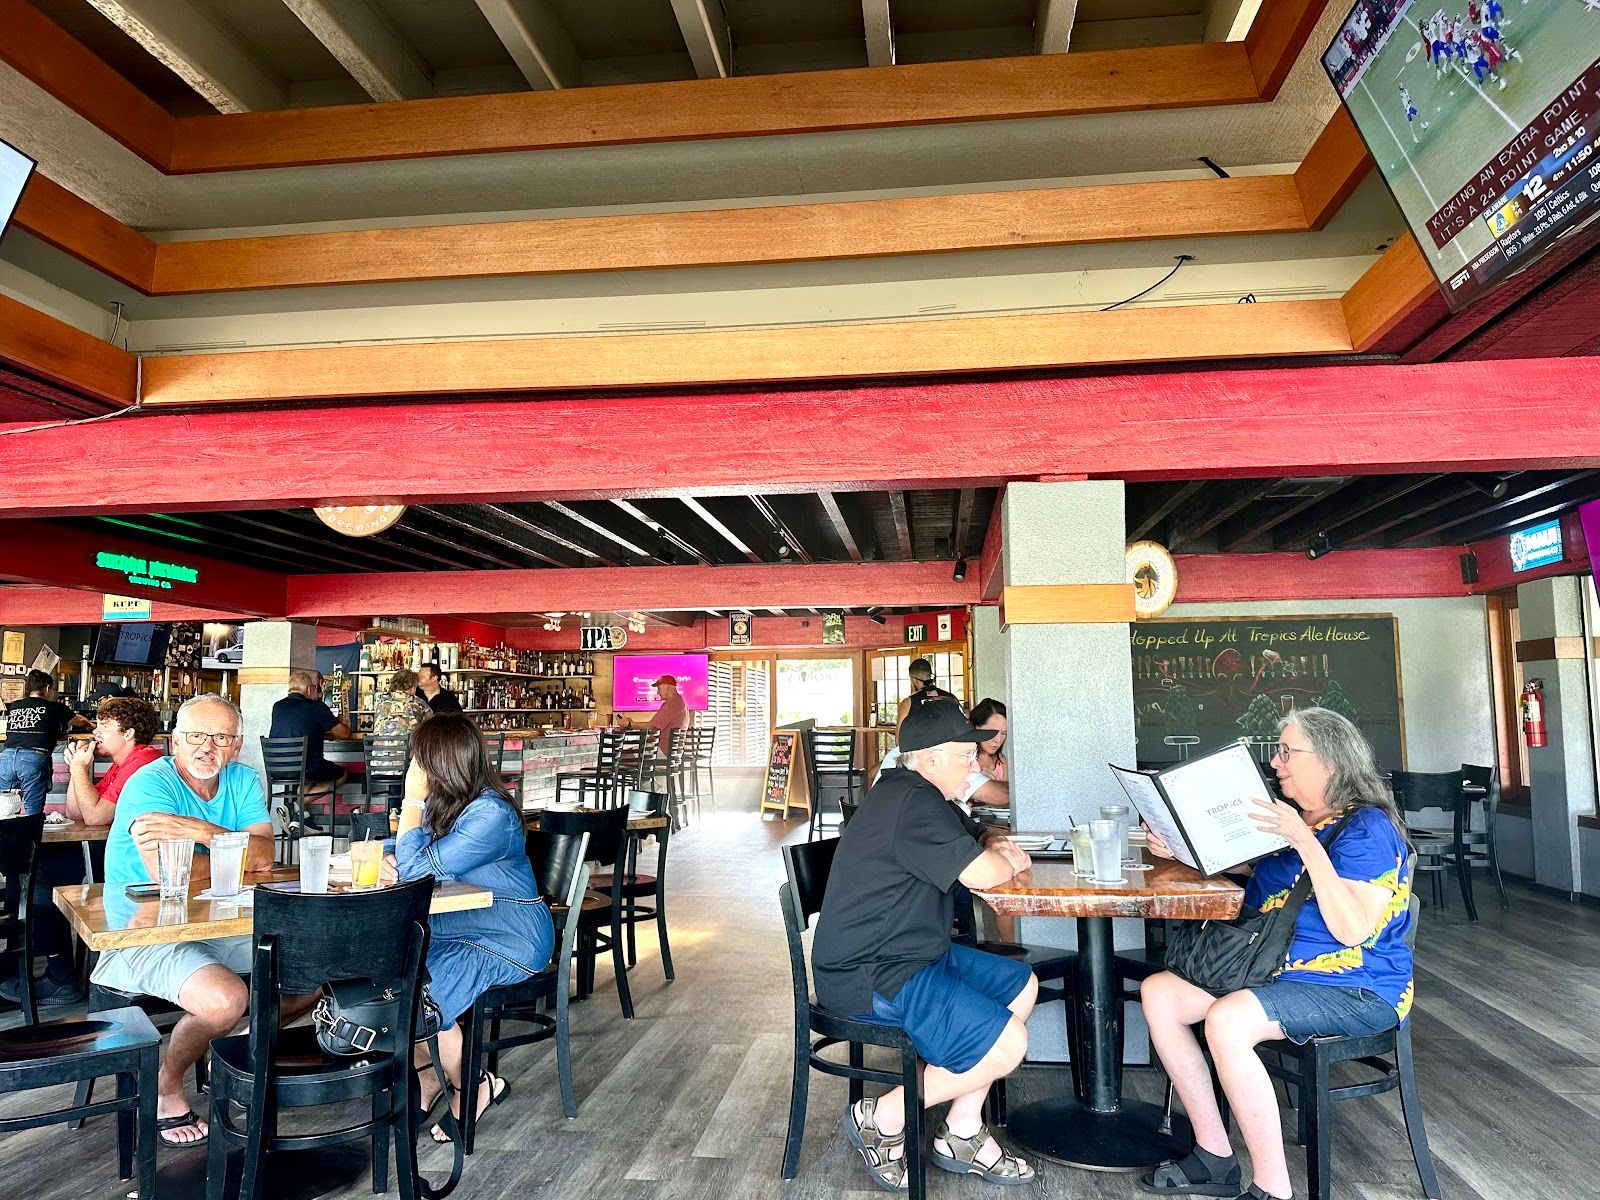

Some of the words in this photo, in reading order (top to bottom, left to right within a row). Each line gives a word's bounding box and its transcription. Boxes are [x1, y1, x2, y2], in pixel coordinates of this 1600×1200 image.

[1432, 185, 1476, 229] KICKING
[1480, 166, 1495, 186] AN
[1499, 126, 1540, 166] EXTRA
[1543, 76, 1587, 125] POINT
[1552, 144, 1568, 158] 2ND
[1567, 136, 1577, 146] &
[1575, 126, 1586, 138] 10
[1440, 215, 1465, 241] IT'S
[1469, 205, 1478, 217] A
[1480, 187, 1496, 207] 24
[1500, 147, 1537, 188] POINT
[1544, 109, 1588, 147] GAME.
[1552, 170, 1565, 182] 4TH
[1565, 145, 1593, 171] 11:50
[1522, 174, 1548, 201] 12
[1483, 194, 1509, 219] DELAWARE
[1500, 228, 1521, 248] Raptors
[1534, 207, 1547, 221] 105
[1548, 190, 1570, 209] Celtics
[1505, 244, 1517, 257] BOS
[1534, 225, 1542, 237] 33
[1478, 245, 1500, 265] PRESEASON
[1449, 269, 1471, 291] ESPN
[327, 514, 387, 531] BREWING
[580, 627, 613, 650] IPA
[908, 625, 924, 642] EXIT
[1194, 629, 1215, 649] Up
[1219, 626, 1238, 643] At
[1247, 627, 1297, 645] Tropics
[1300, 626, 1323, 642] Ale
[1325, 626, 1370, 642] House
[8, 713, 42, 723] ALOHA
[9, 706, 46, 717] SERVING
[10, 720, 38, 730] DAILY
